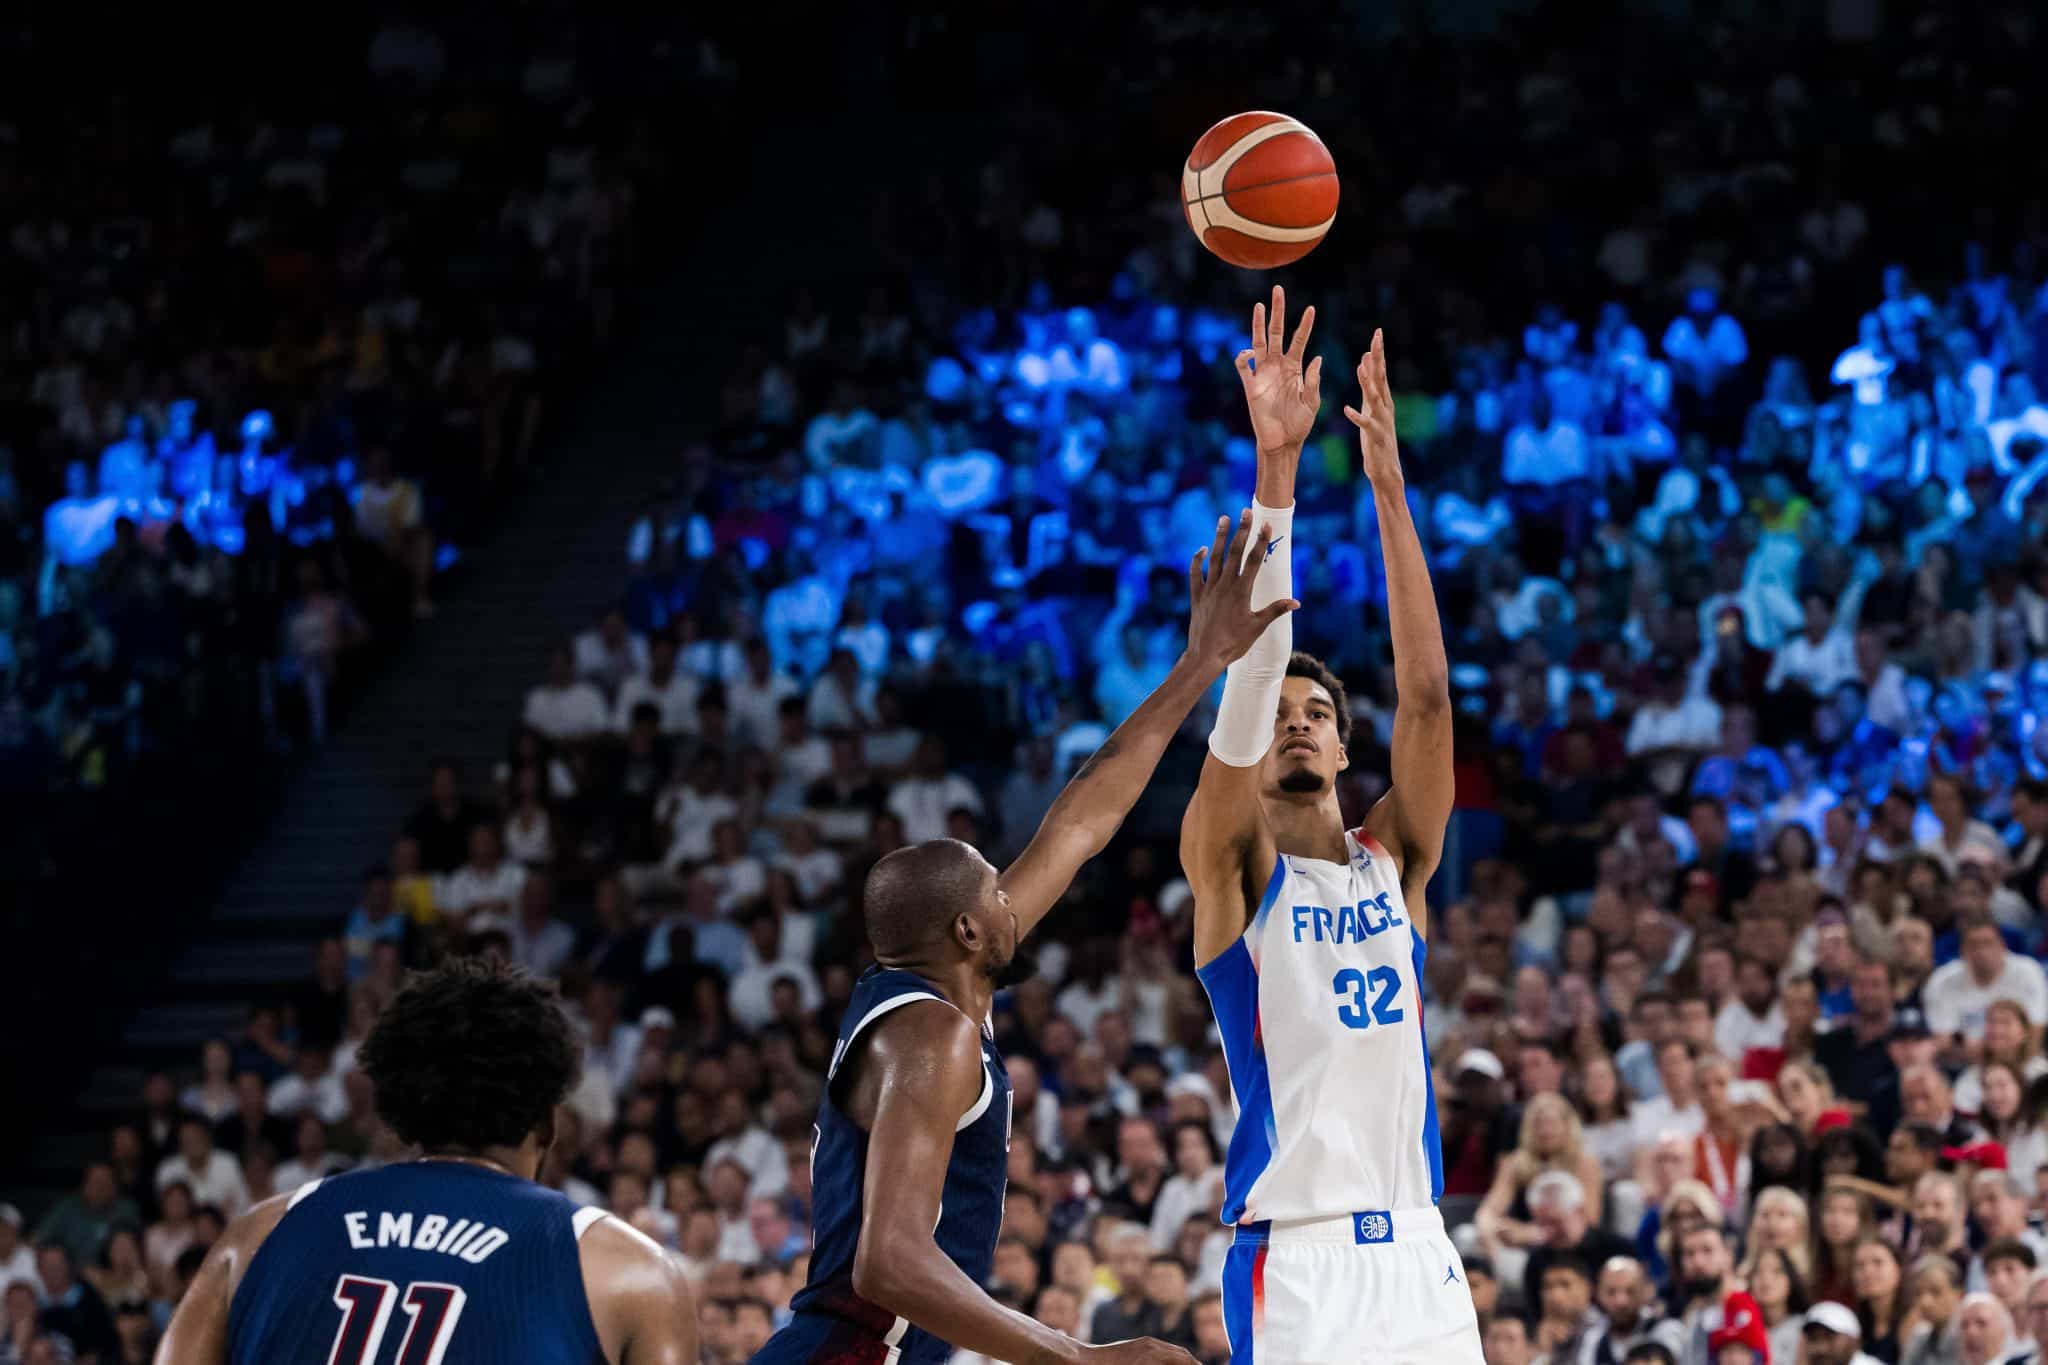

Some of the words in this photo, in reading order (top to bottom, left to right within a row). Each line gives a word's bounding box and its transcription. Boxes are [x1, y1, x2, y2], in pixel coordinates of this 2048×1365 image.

[1292, 891, 1403, 945] FRACE
[1332, 965, 1404, 1029] 32
[344, 1210, 510, 1264] EMBIID
[326, 1273, 468, 1365] 11
